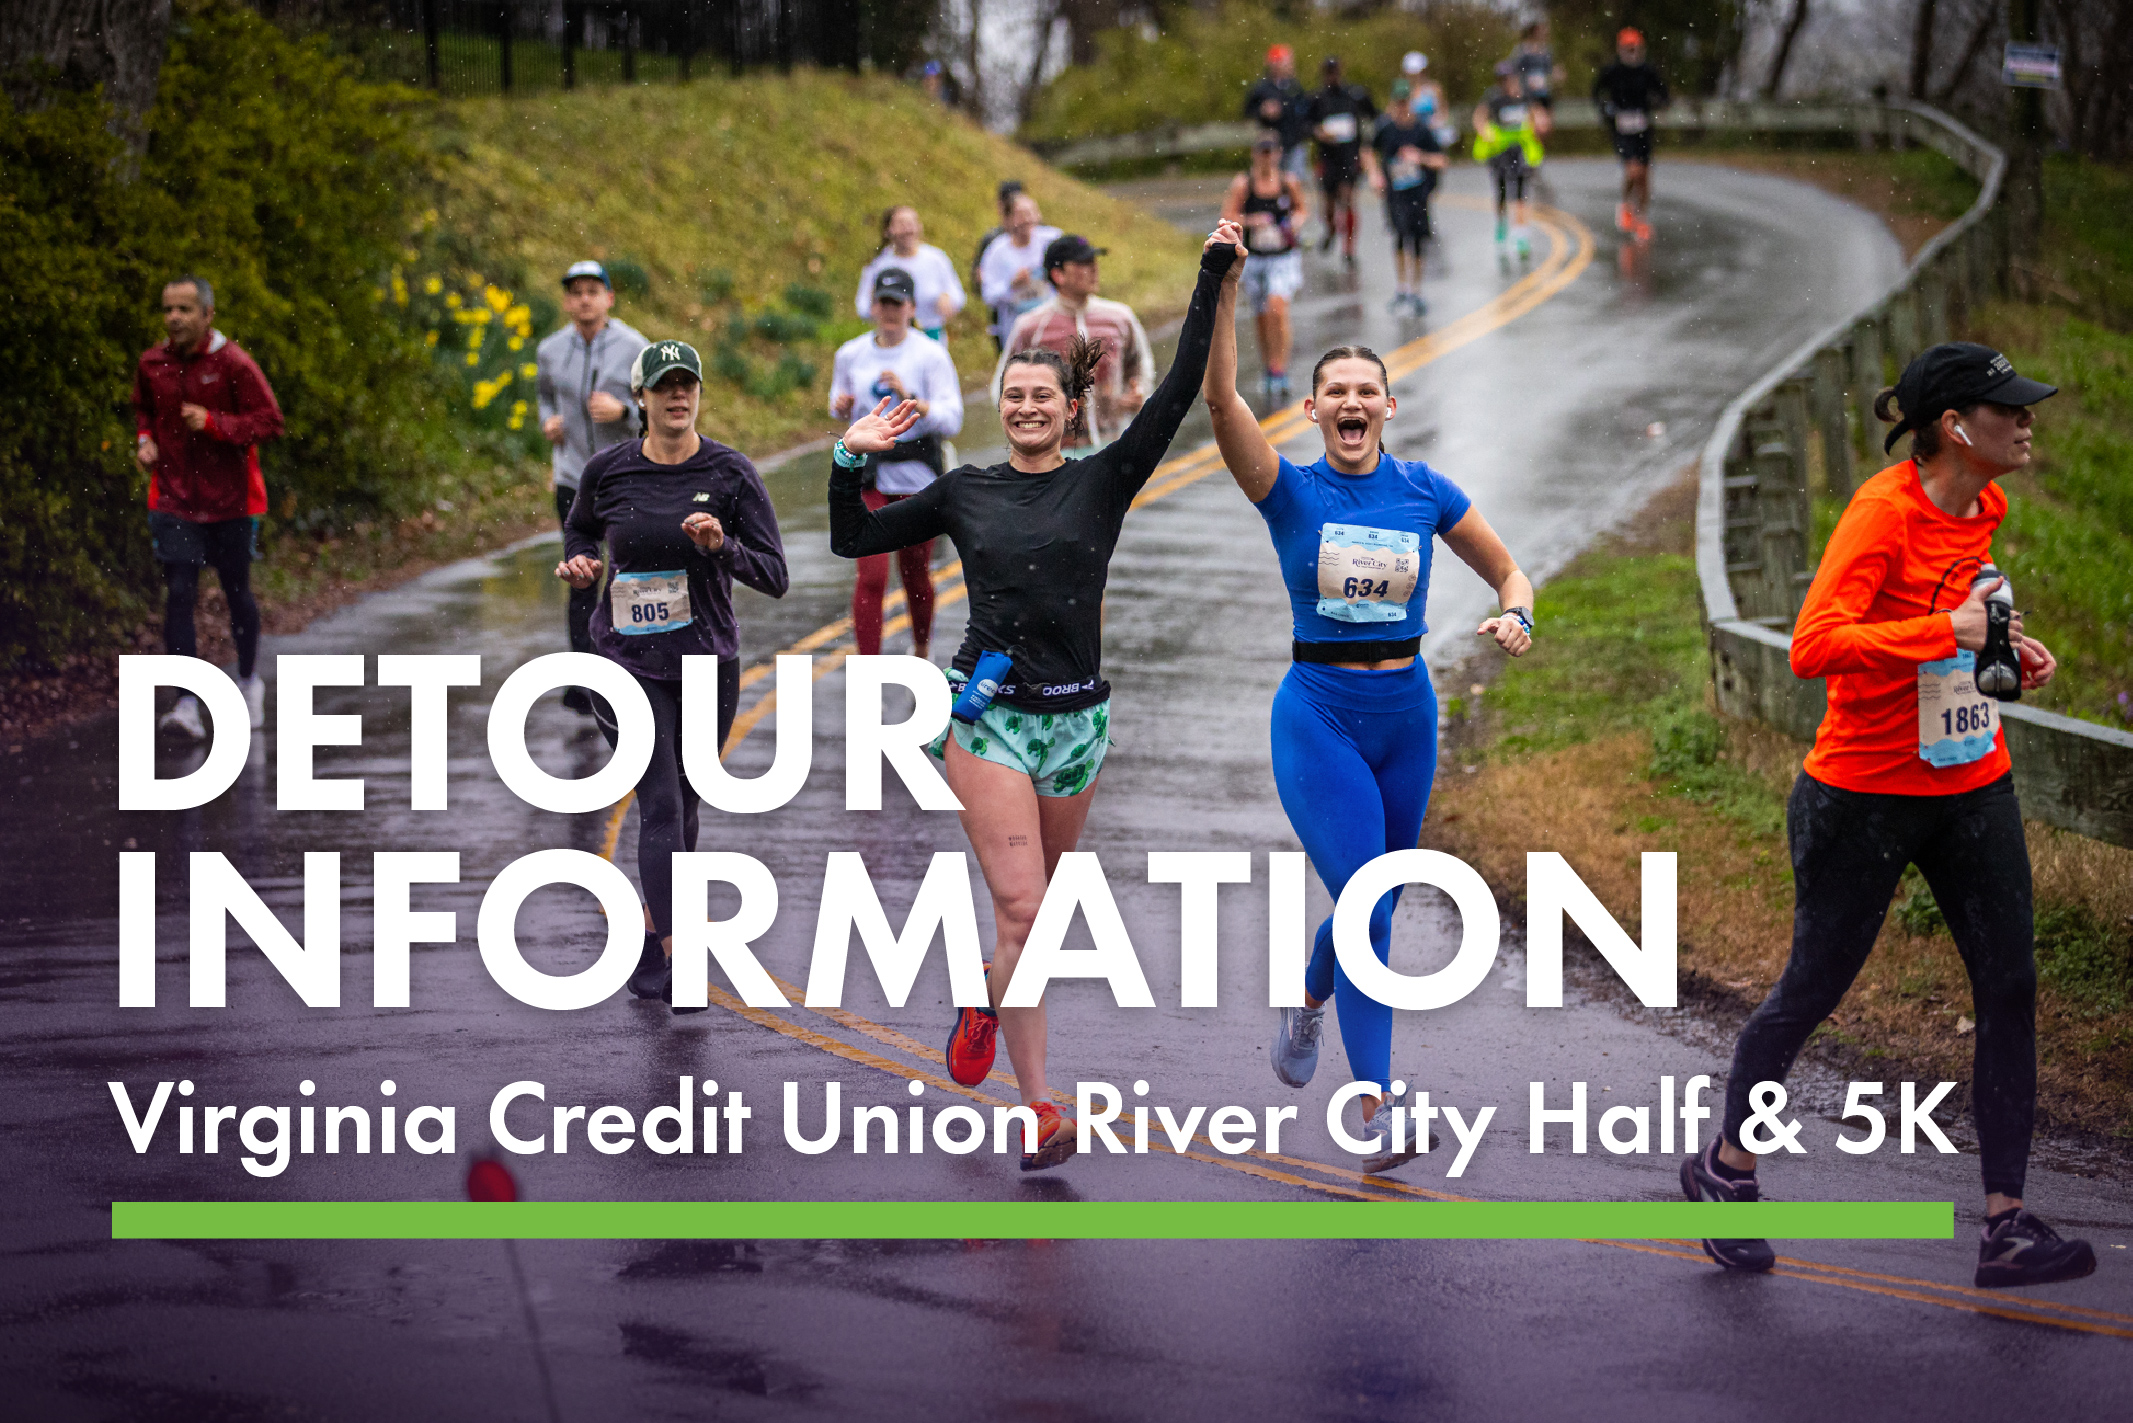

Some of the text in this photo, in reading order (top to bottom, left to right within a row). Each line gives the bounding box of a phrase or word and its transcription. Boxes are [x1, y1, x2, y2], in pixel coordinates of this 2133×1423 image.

[660, 345, 681, 361] NY
[1343, 577, 1389, 598] 634
[631, 602, 669, 623] 805
[1941, 702, 1989, 735] 1863
